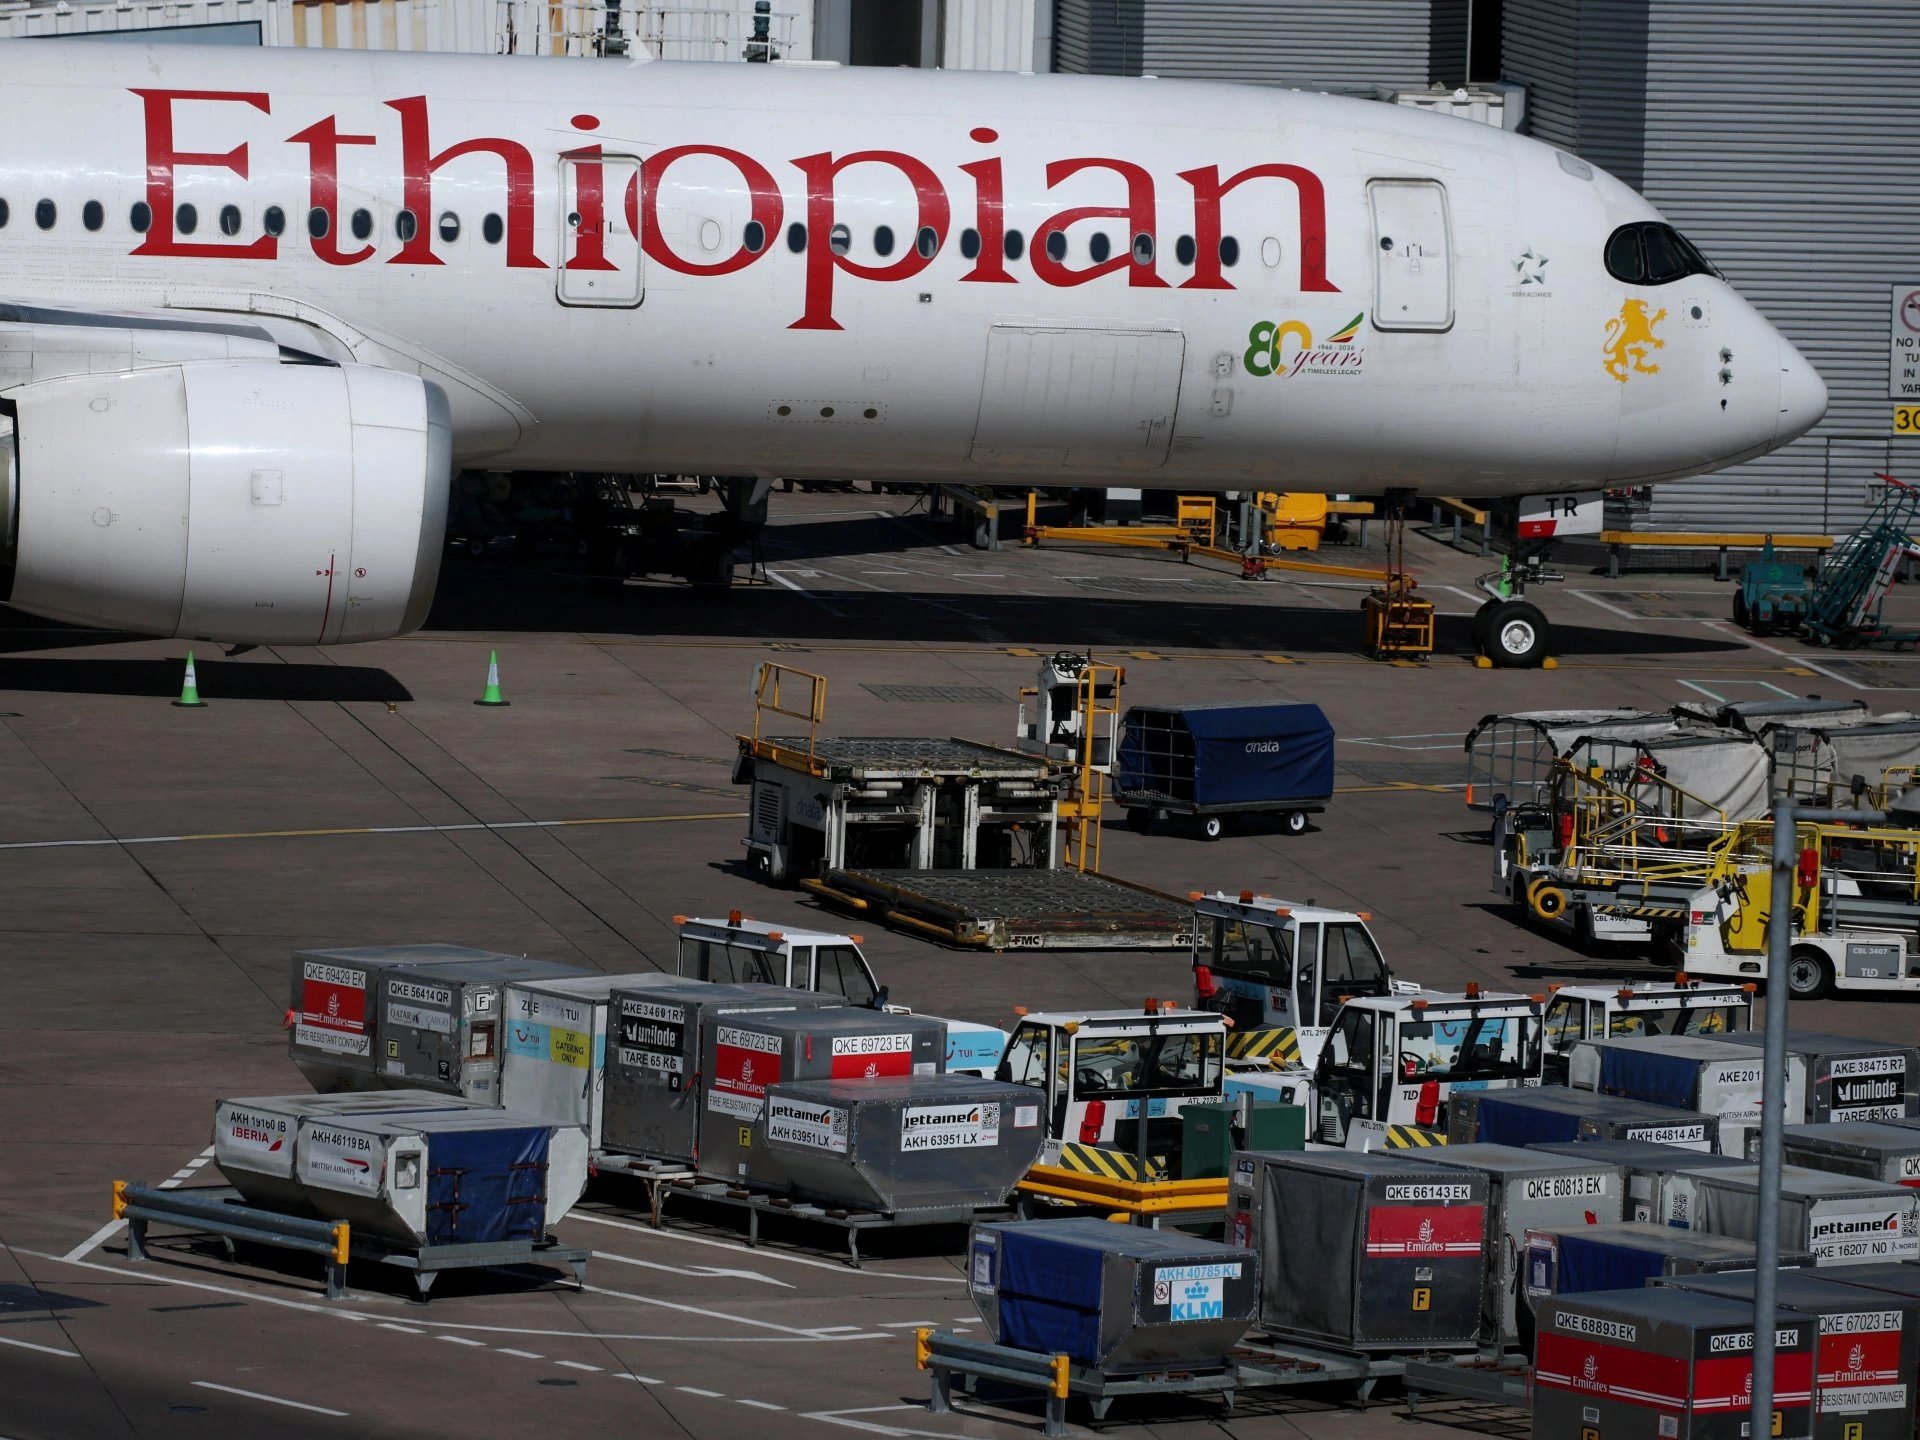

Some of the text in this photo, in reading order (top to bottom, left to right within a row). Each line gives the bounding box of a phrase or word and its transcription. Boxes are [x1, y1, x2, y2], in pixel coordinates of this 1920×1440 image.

[127, 87, 1343, 331] Ethiopian
[1243, 320, 1312, 377] 80
[1896, 337, 1914, 347] NO
[1283, 348, 1364, 379] years
[1338, 368, 1362, 376] LEGACY
[1903, 369, 1915, 378] IN
[1545, 497, 1578, 518] TR
[1245, 740, 1280, 753] dnata
[1012, 935, 1040, 946] FMC
[305, 964, 364, 987] QKE 69429 EK
[1861, 967, 1879, 977] TLD
[390, 982, 449, 1003] QKE 56414 QR
[389, 1008, 412, 1020] QATAR
[565, 1008, 580, 1021] TUI
[623, 1002, 642, 1014] AKE
[318, 1013, 349, 1028] Emirates
[297, 1029, 369, 1051] FIRE RESISTANT CONTAINER
[530, 1035, 540, 1043] TUI
[638, 1024, 676, 1048] unilode
[718, 1028, 780, 1053] QKE 69723 EK
[555, 1041, 584, 1055] CATERING
[834, 1036, 911, 1053] QKE 69723 EK
[561, 1053, 577, 1064] ONLY
[624, 1050, 677, 1069] TARE 65 KG
[958, 1049, 973, 1058] TUI
[1834, 1059, 1904, 1074] AKE 38475 R7
[1718, 1071, 1741, 1083] AKE
[731, 1079, 762, 1093] Emirates
[1852, 1078, 1897, 1100] unilode
[1403, 1089, 1418, 1101] TLD
[709, 1096, 721, 1107] FIRE
[722, 1097, 751, 1112] RESISTANT
[230, 1111, 249, 1125] AKH
[277, 1119, 287, 1132] IB
[770, 1105, 831, 1124] jettainer
[904, 1107, 979, 1129] jettainer
[1718, 1111, 1742, 1119] BRITISH
[1838, 1110, 1866, 1122] TARE
[1882, 1108, 1898, 1120] KG
[1360, 1121, 1385, 1131] ATL 2176
[232, 1127, 269, 1143] IBERIA
[311, 1130, 371, 1151] AKH 46119 BA
[771, 1126, 790, 1139] AKH
[792, 1129, 816, 1144] 63951
[818, 1135, 830, 1147] LX
[904, 1132, 978, 1148] AKH 63951 LX
[1630, 1128, 1702, 1142] AKH 64814 AF
[1046, 1141, 1059, 1149] 2178
[311, 1161, 356, 1175] BRITISH AIRWAYS
[1387, 1185, 1469, 1199] QKE 66143 EK
[1528, 1176, 1601, 1199] QKE 60813 EK
[1812, 1212, 1898, 1239] jettainer
[1406, 1240, 1444, 1252] Emirates
[1814, 1246, 1834, 1258] AKE
[1838, 1244, 1867, 1256] 16207
[1899, 1242, 1918, 1250] NORSE
[1158, 1264, 1238, 1281] AKH 40785 KL
[1417, 1291, 1426, 1308] F
[1171, 1300, 1222, 1320] KLM
[1557, 1313, 1634, 1340] QKE 68893 EK
[1819, 1312, 1901, 1333] QKE 67023 EK
[1712, 1335, 1736, 1350] QKE
[1780, 1331, 1796, 1345] EK
[1572, 1375, 1608, 1393] Emirates
[1834, 1370, 1876, 1382] Emirates
[1822, 1390, 1904, 1407] RESISTANT CONTAINER
